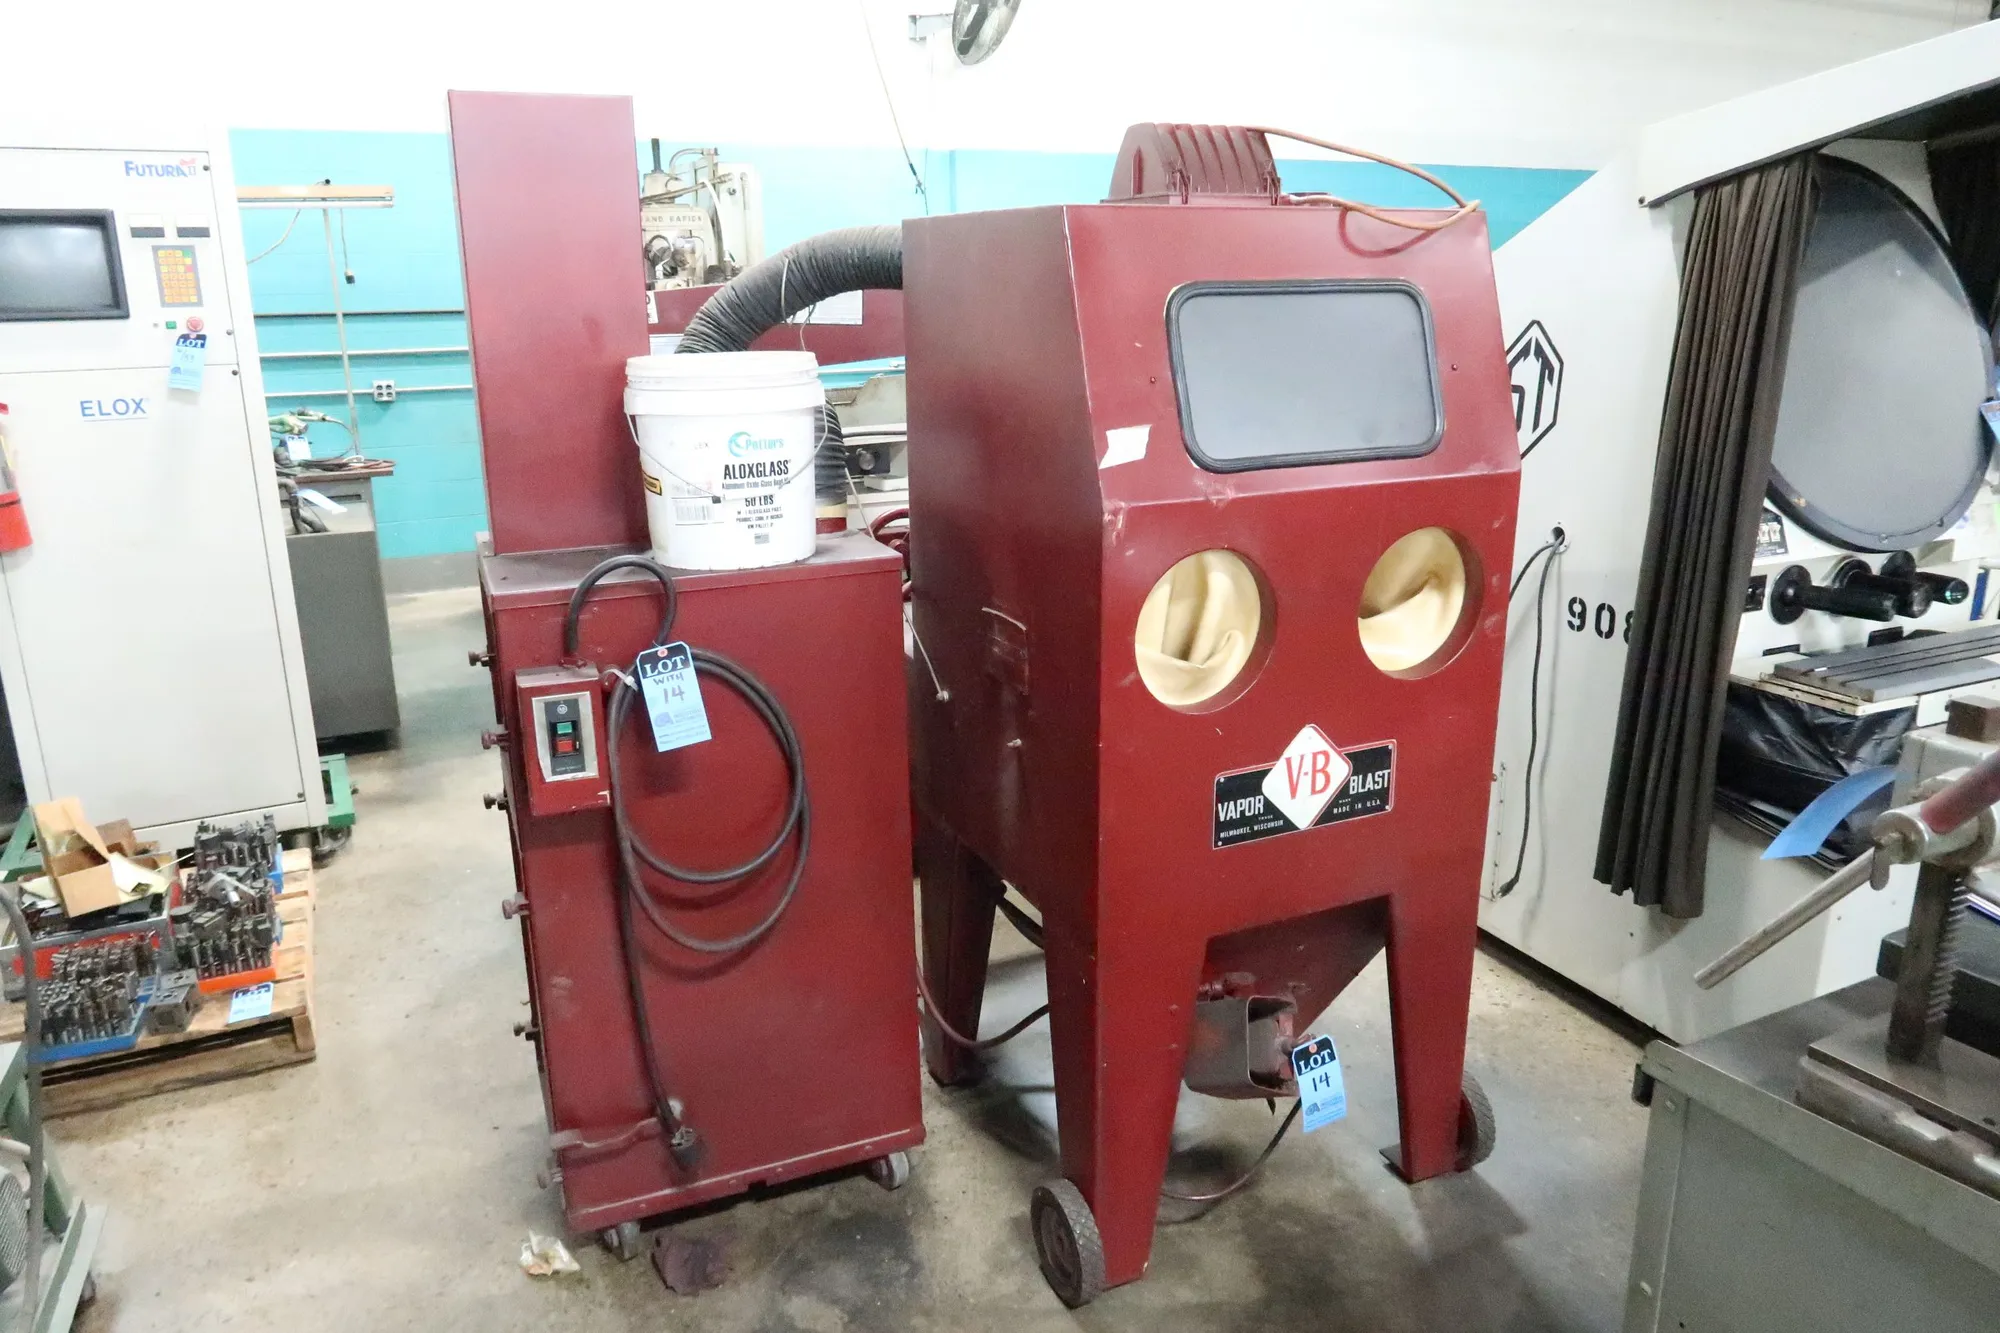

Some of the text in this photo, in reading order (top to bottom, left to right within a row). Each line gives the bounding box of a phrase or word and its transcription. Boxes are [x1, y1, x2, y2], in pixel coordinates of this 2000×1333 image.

[80, 397, 147, 417] ELOX
[723, 459, 789, 480] ALOXGLASS
[759, 494, 774, 506] LBS
[643, 655, 685, 678] LOT
[653, 672, 685, 686] WITH
[663, 685, 685, 704] 14
[1349, 769, 1391, 794] BLAST
[1217, 794, 1264, 822] VAPOR
[1332, 804, 1350, 815] MADE
[1354, 802, 1363, 810] IN
[1253, 819, 1284, 831] WISCONSIN
[1298, 1049, 1331, 1073] LOT
[1312, 1071, 1331, 1092] 14
